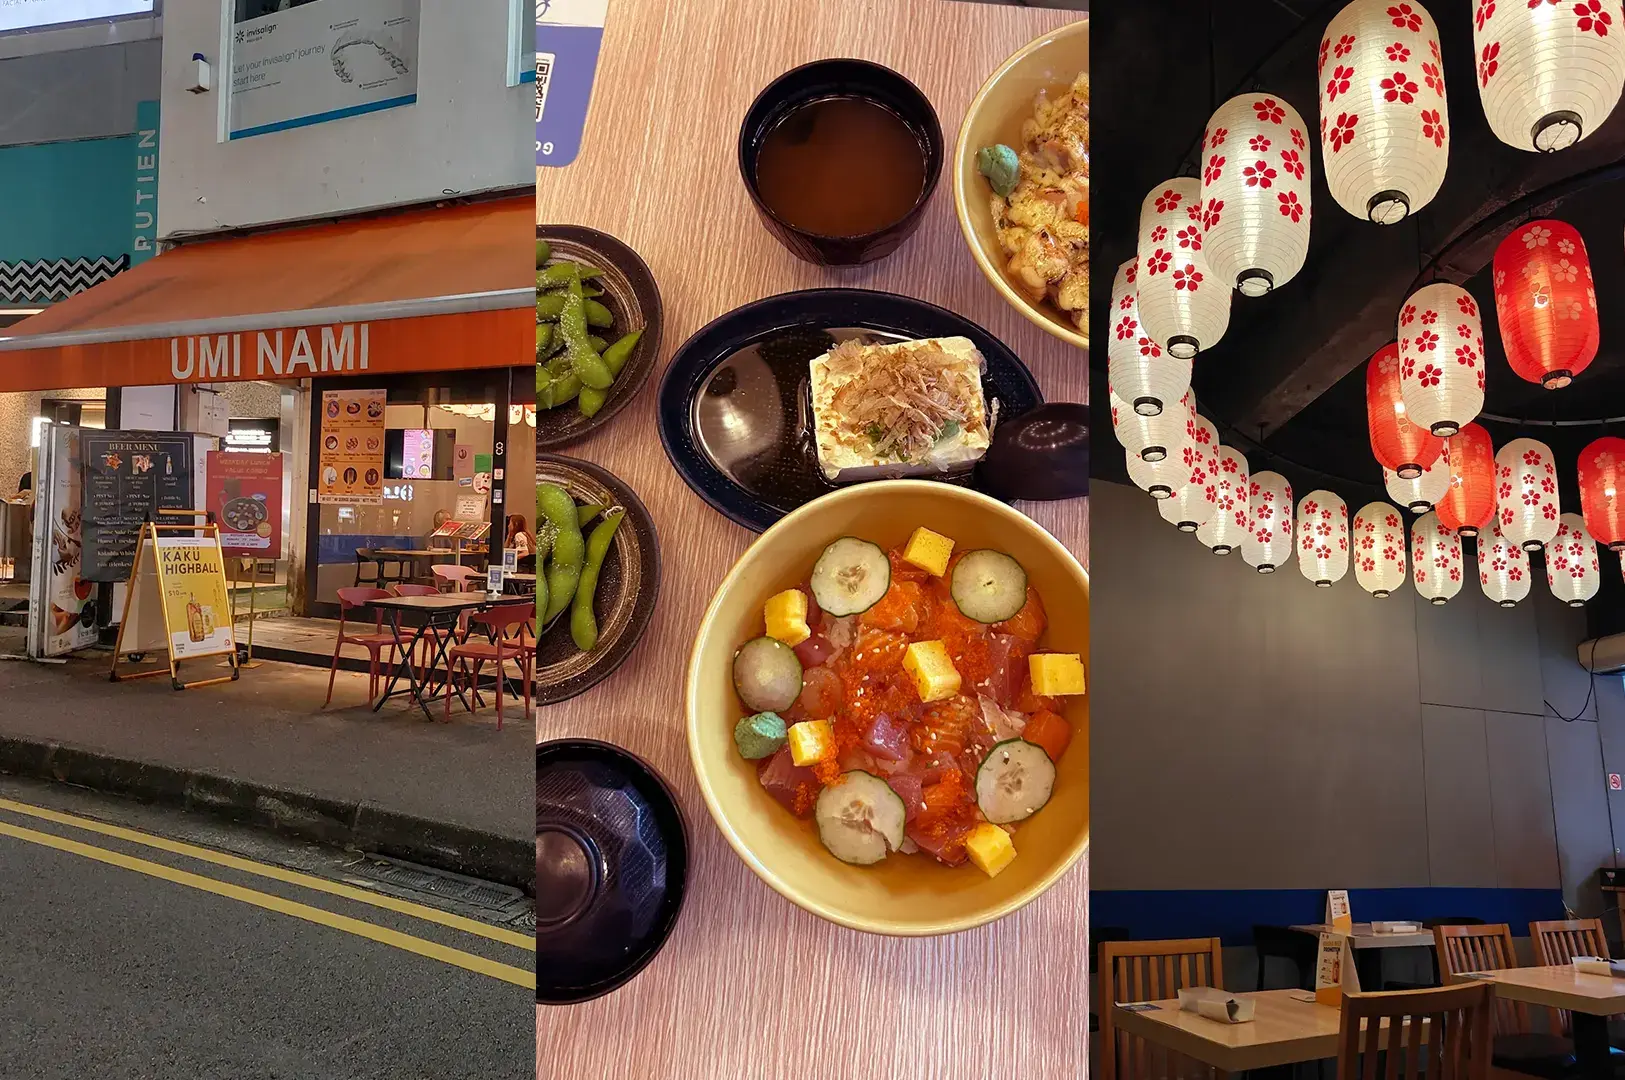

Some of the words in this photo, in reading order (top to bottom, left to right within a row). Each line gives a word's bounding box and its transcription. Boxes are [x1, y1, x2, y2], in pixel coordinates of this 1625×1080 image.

[246, 60, 261, 72] your
[298, 45, 326, 59] journey
[233, 76, 249, 87] start
[250, 73, 266, 83] here
[134, 129, 156, 251] PUTIEN
[171, 334, 241, 380] UMI
[257, 323, 369, 375] NAMI
[109, 443, 133, 451] BEER
[134, 443, 159, 451] MENU
[163, 551, 200, 562] KAKU
[165, 563, 219, 576] HIGHBALL
